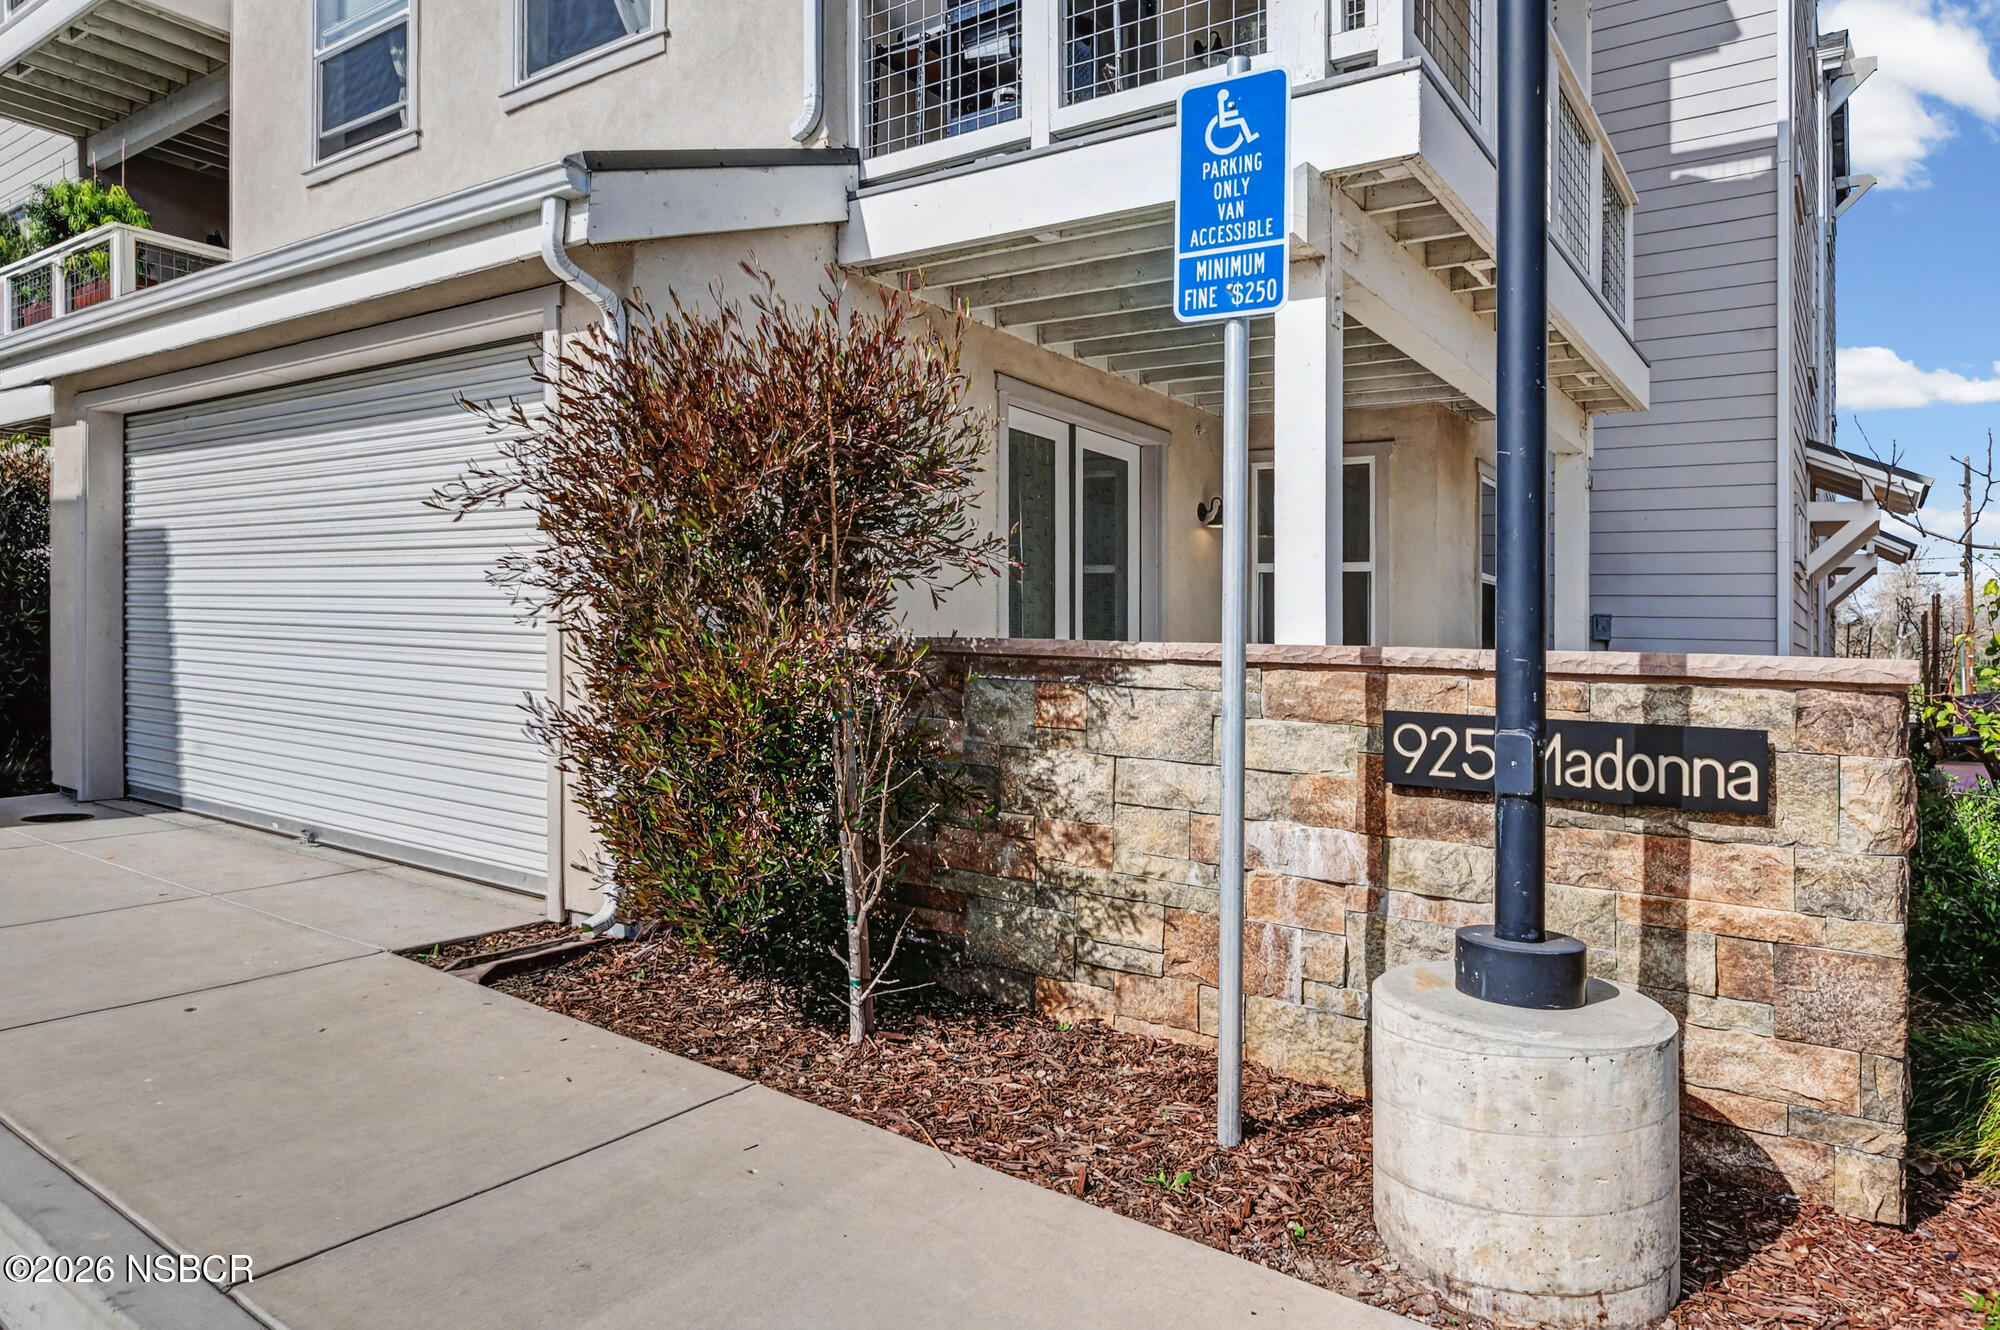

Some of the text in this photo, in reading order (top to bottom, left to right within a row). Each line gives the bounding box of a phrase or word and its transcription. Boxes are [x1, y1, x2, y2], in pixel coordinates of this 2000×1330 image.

[1202, 152, 1263, 181] PARKING
[1213, 177, 1250, 200] ONLY
[1217, 200, 1244, 221] VAN
[1190, 217, 1273, 248] ACCESSIBLE
[1196, 252, 1265, 282] MINIMUM
[1184, 278, 1277, 311] FINE $250
[1392, 722, 1496, 781] 925
